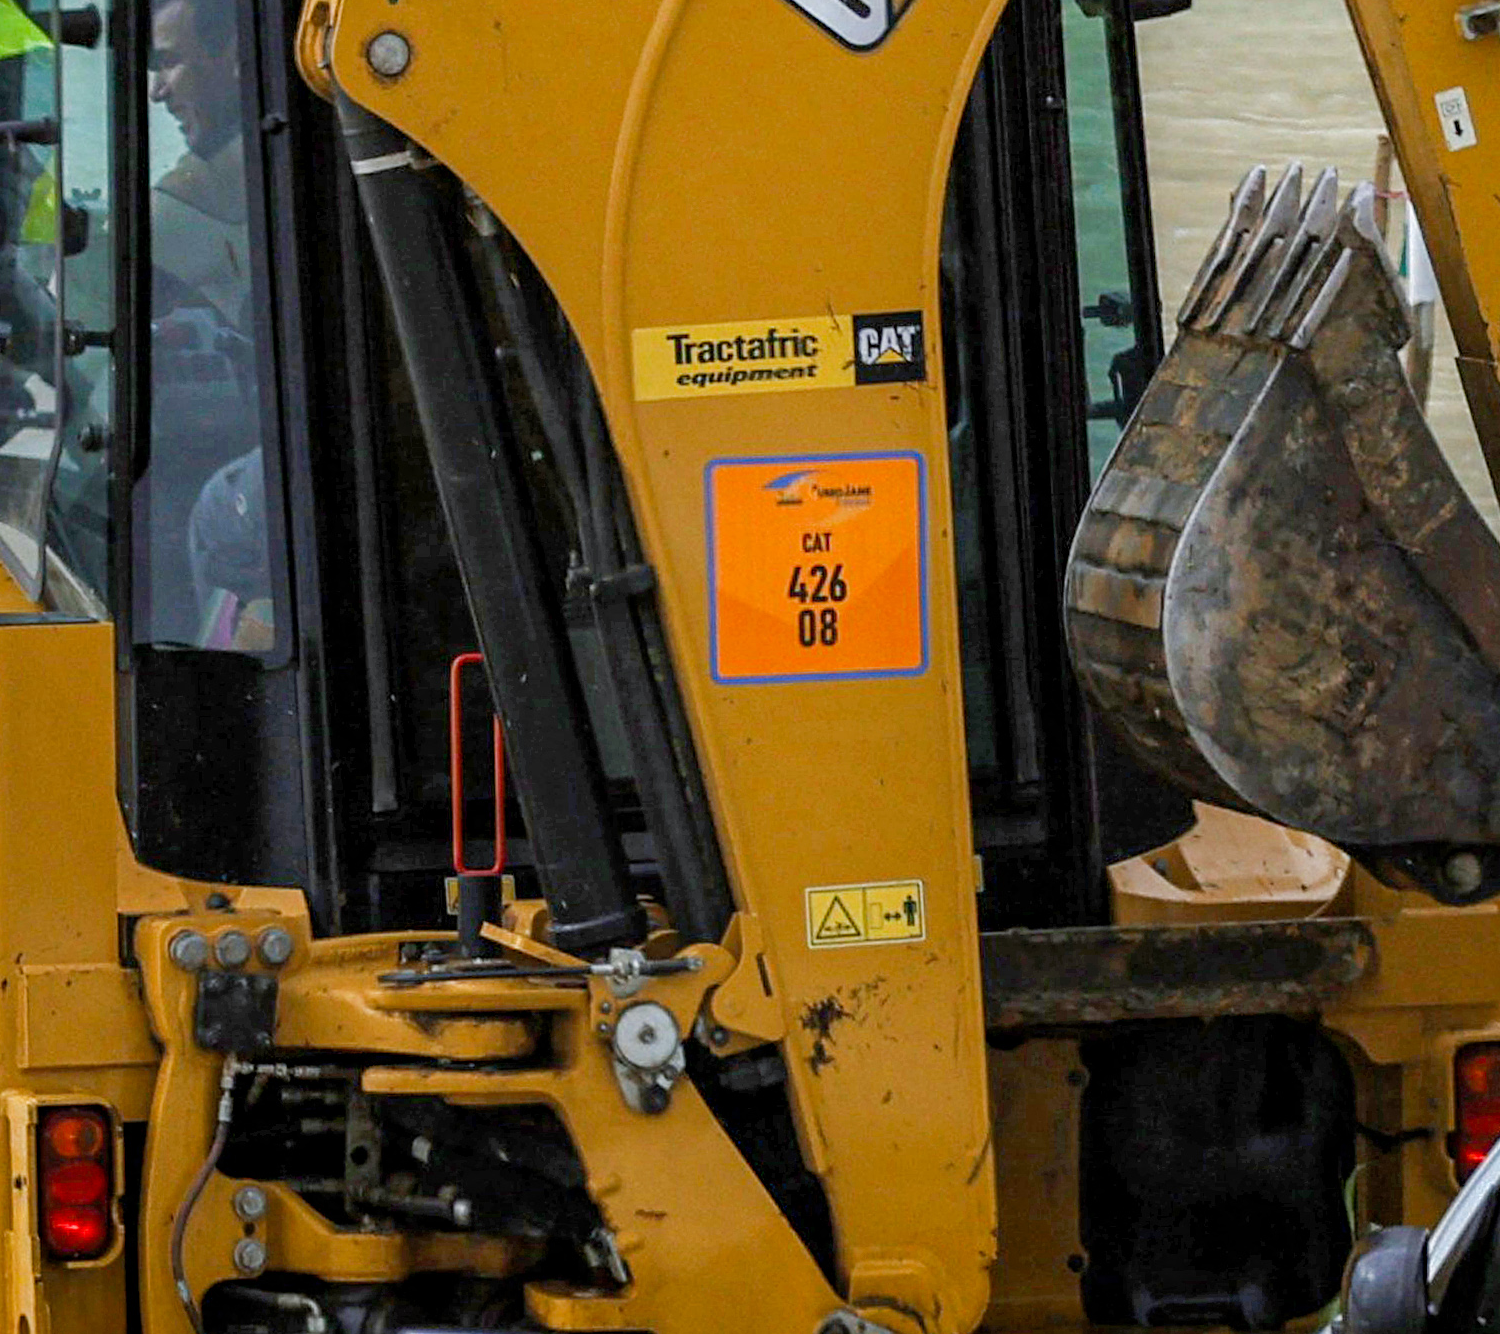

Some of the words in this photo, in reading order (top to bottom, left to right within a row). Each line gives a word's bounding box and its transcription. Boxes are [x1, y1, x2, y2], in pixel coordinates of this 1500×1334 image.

[667, 327, 819, 364] Tractafric
[859, 325, 919, 365] CAT
[676, 364, 817, 387] equipment
[802, 532, 832, 553] CAT
[789, 564, 847, 603] 426
[798, 608, 839, 647] 08
